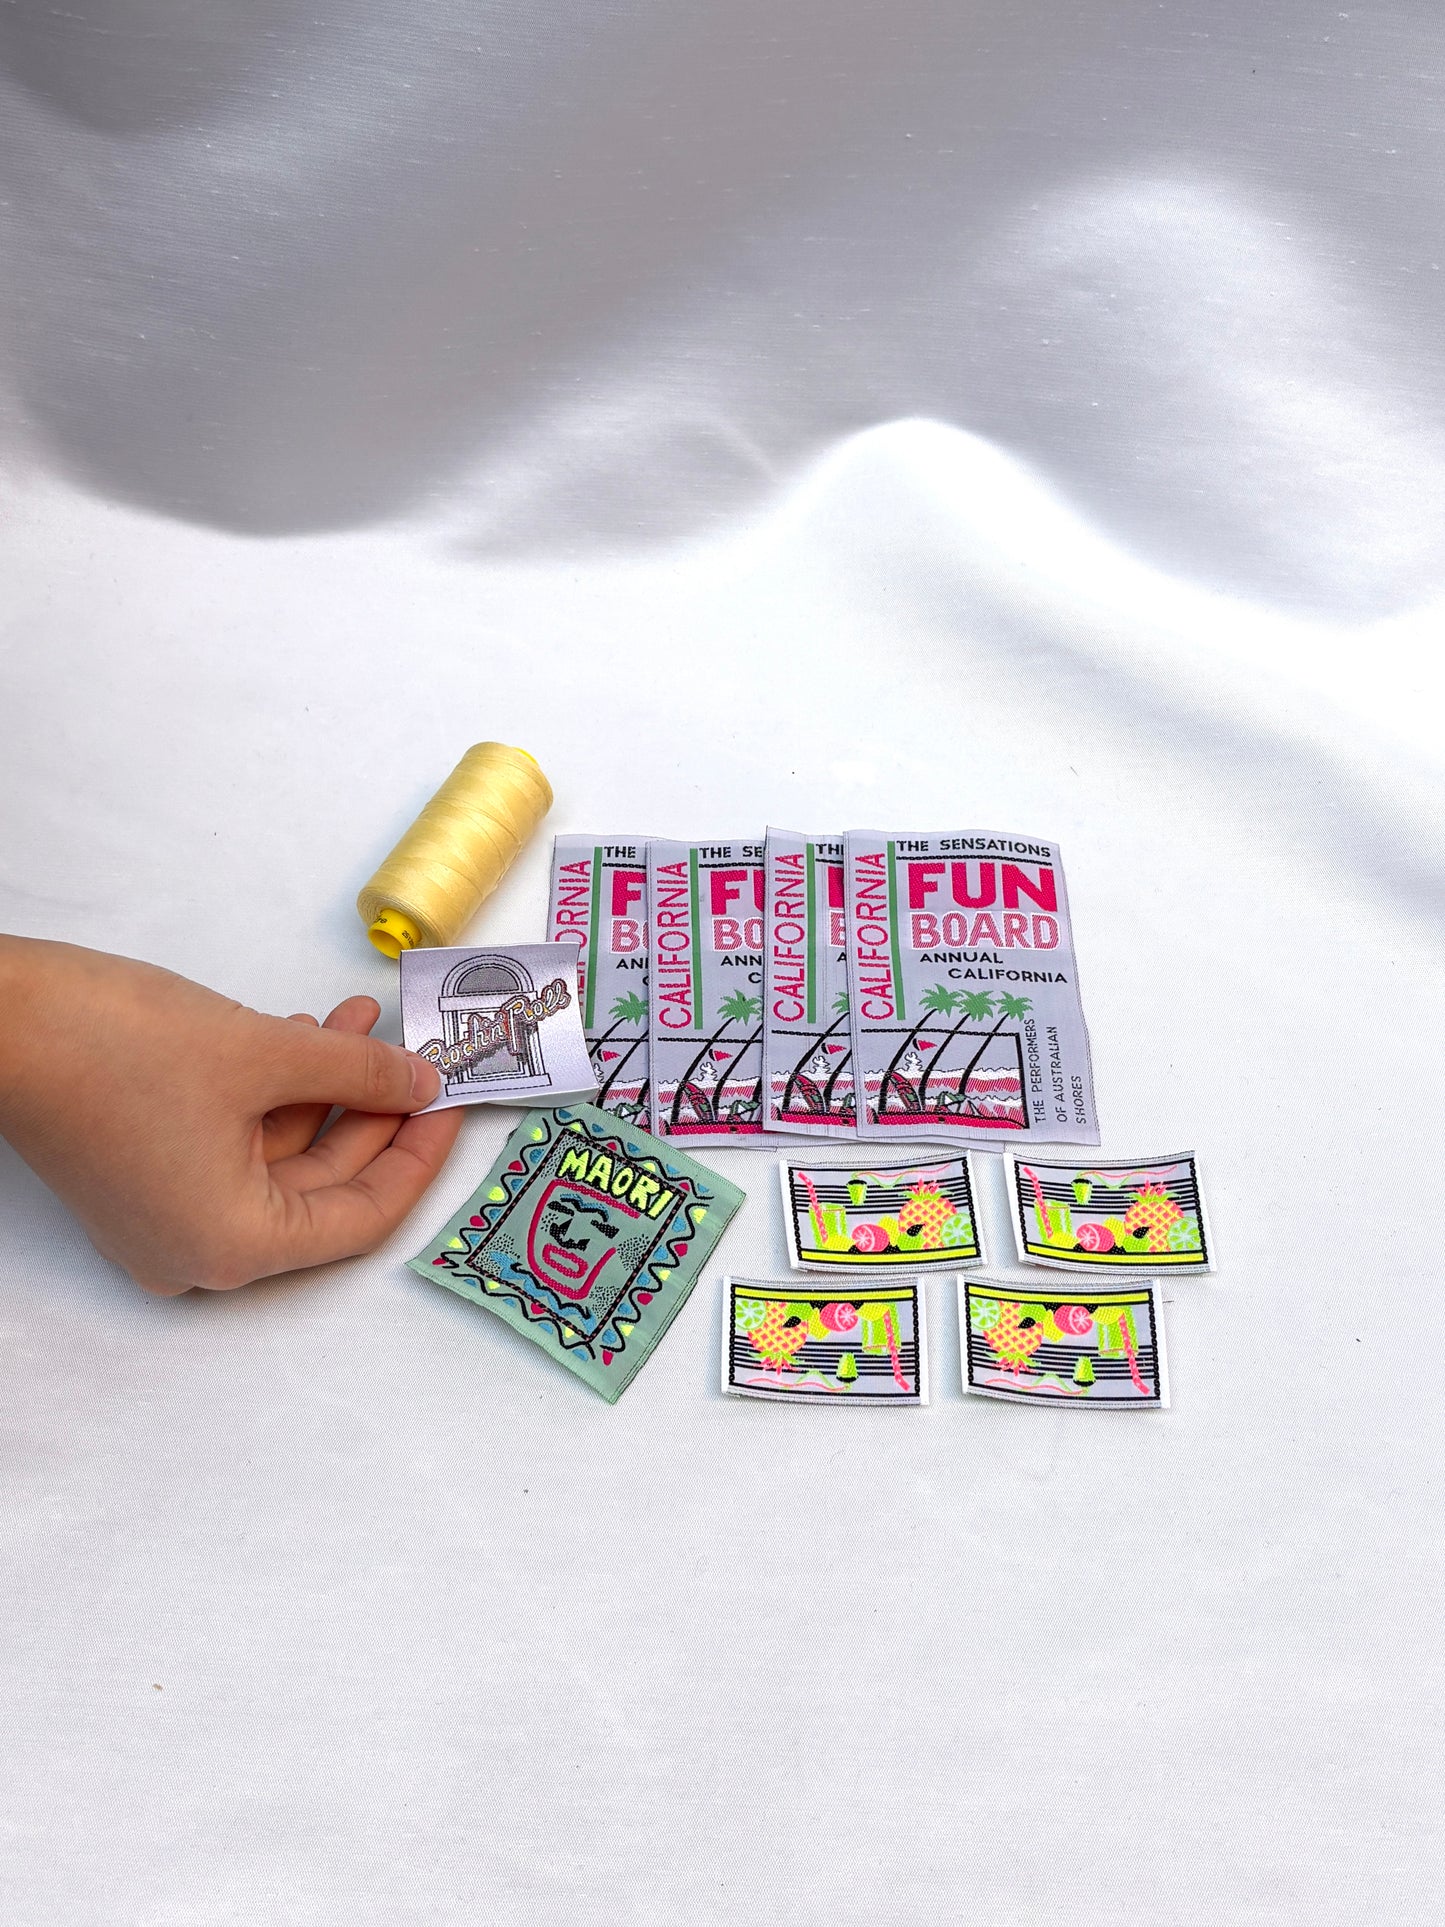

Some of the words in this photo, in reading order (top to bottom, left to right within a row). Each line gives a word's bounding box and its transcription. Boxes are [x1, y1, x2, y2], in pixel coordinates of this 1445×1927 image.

[603, 845, 636, 859] THE
[699, 846, 731, 859] THE
[896, 840, 929, 852] THE
[939, 838, 1051, 858] SENSATIONS
[907, 861, 1058, 912] FUN
[656, 861, 692, 1029] CALIFORNIA
[773, 853, 805, 1022] CALIFORNIA
[855, 853, 894, 1020] CALIFORNIA
[910, 911, 1060, 950] BOARD
[720, 955, 762, 967] ANN
[920, 952, 1003, 965] ANNUAL
[948, 968, 1068, 983] CALIFORNIA
[1024, 1019, 1042, 1092] PERFORMERS
[1046, 1026, 1065, 1102] AUSTRALIAN
[1033, 1100, 1046, 1123] THE
[1055, 1106, 1068, 1122] OF
[1071, 1075, 1087, 1124] SHORES
[555, 1146, 677, 1220] MAORI
